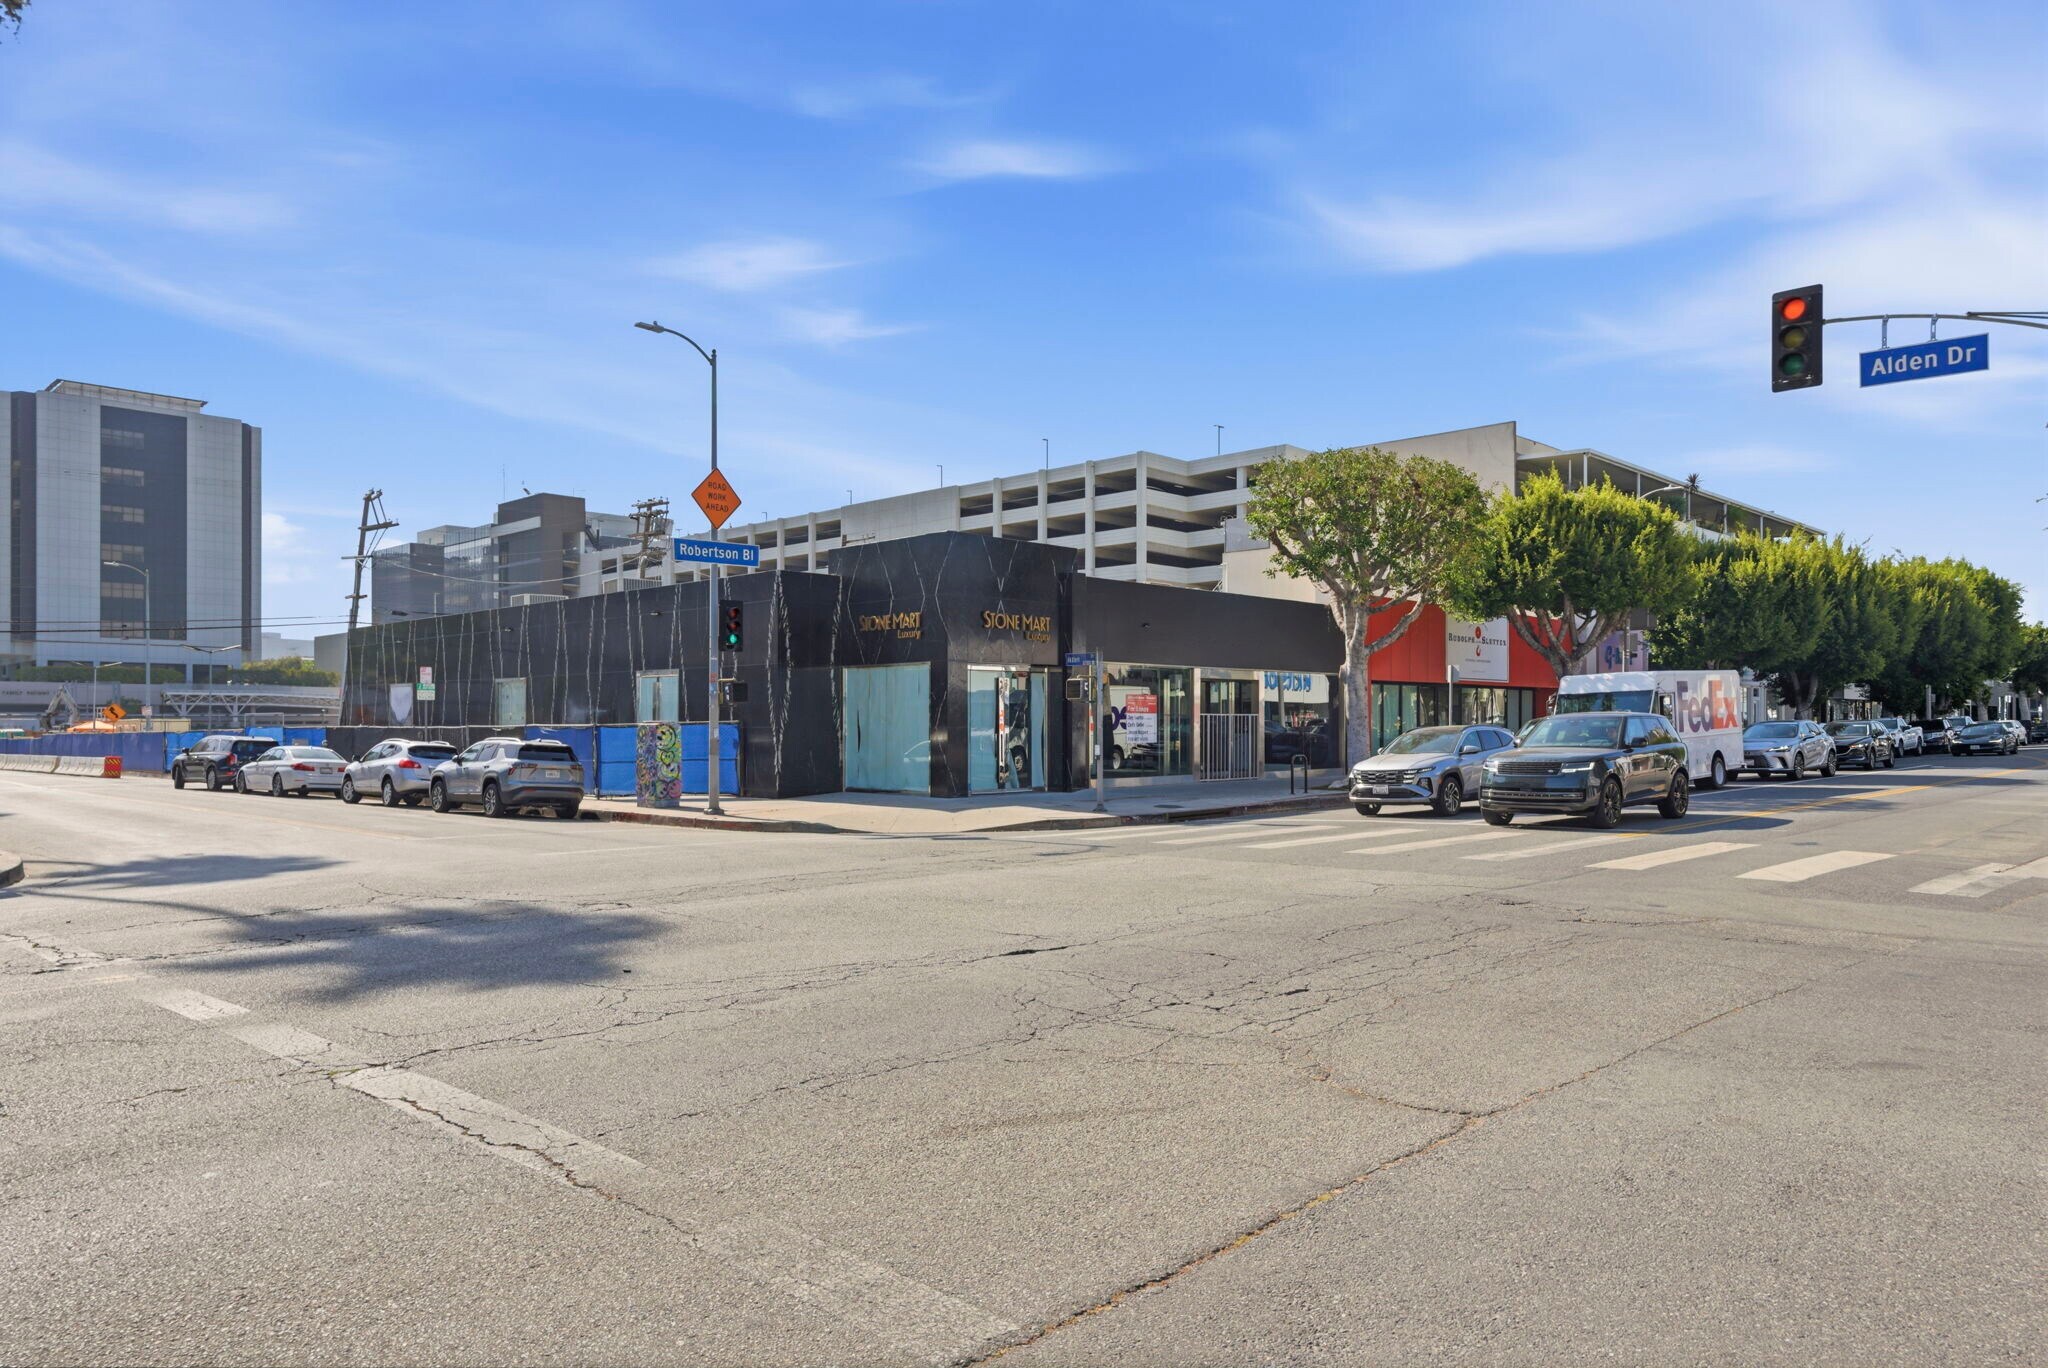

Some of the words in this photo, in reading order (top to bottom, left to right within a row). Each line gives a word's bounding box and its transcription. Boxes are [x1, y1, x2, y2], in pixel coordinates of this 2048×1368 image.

[1871, 352, 1938, 376] Alden
[1947, 346, 1977, 365] Dr
[707, 481, 727, 491] ROAD
[707, 492, 727, 501] WORK
[706, 502, 729, 513] AHEAD
[680, 543, 739, 560] Robertson
[743, 549, 754, 561] Bl
[859, 615, 892, 631] STONE
[892, 612, 921, 630] MART
[983, 610, 1020, 630] STONE
[1022, 614, 1051, 632] MART
[1676, 680, 1739, 732] FedEx
